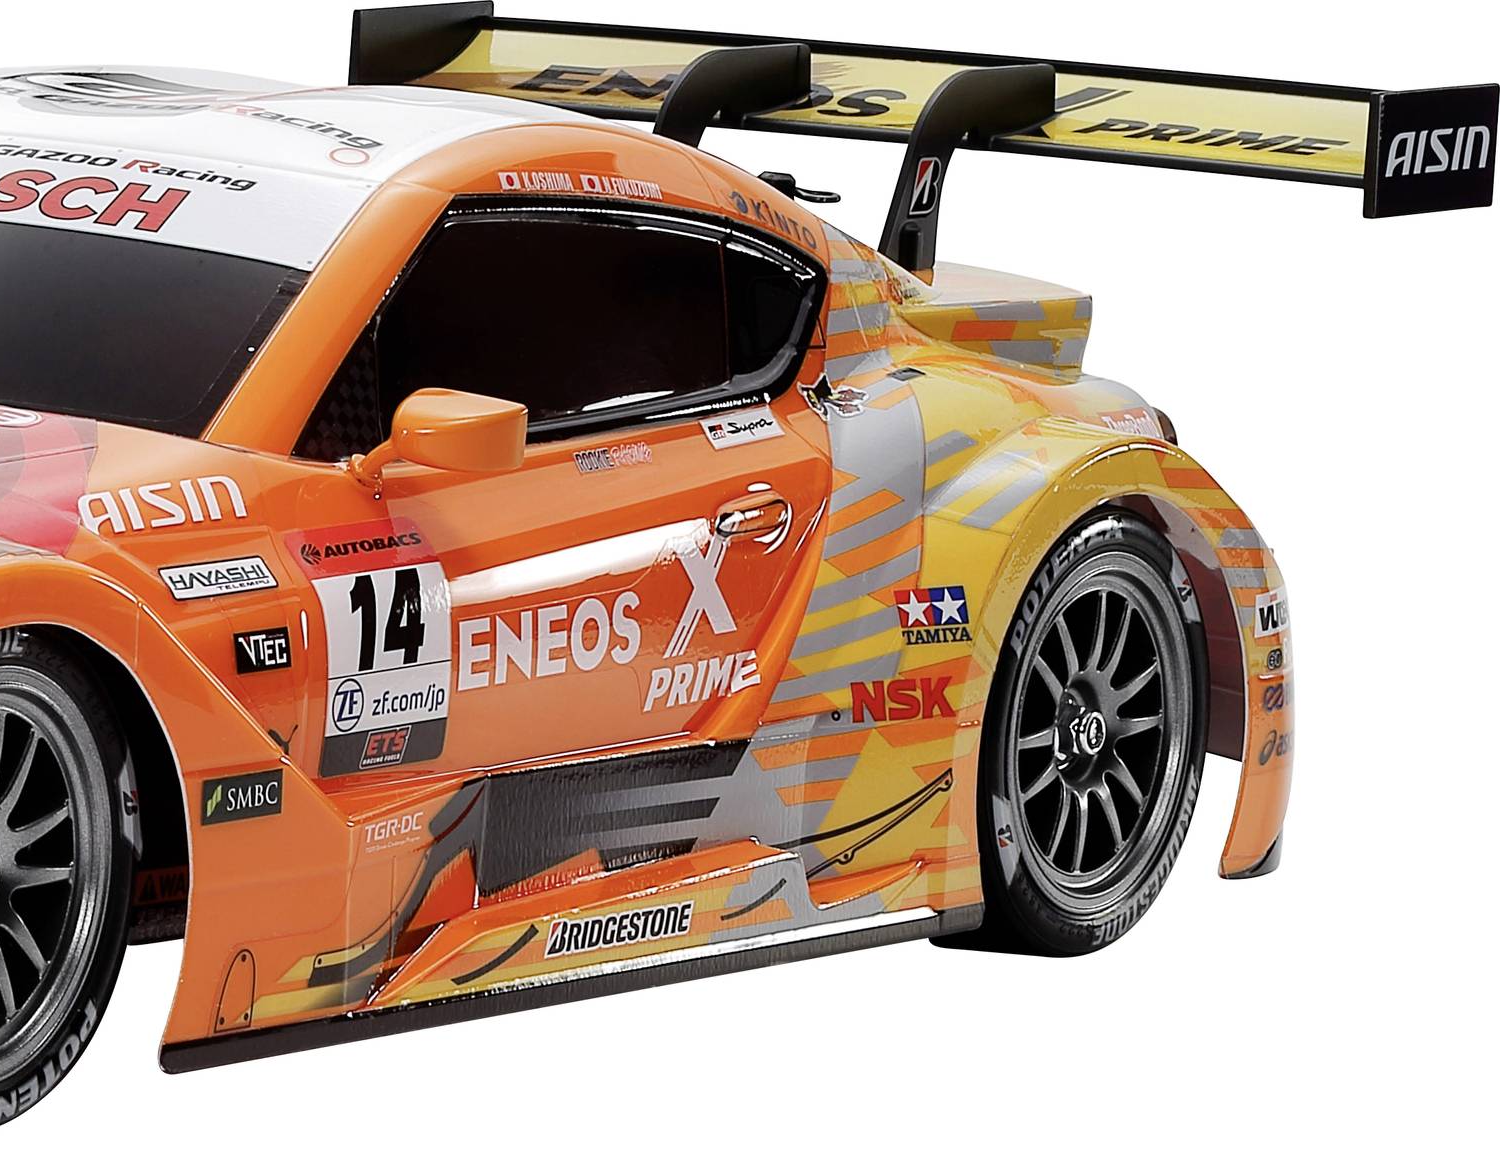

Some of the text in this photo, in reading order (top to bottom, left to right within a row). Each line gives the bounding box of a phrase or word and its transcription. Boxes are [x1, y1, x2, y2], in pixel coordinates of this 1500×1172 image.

[213, 103, 385, 150] Racing
[1074, 117, 1351, 156] PRIME
[1384, 124, 1491, 178] AISIN
[121, 158, 259, 192] Racing
[521, 171, 575, 192] K.OSHIMA
[726, 417, 774, 437] Supra
[574, 448, 615, 472] ROOKIE
[77, 475, 248, 534] AISIN
[324, 532, 421, 559] AUTOBACS
[168, 564, 270, 590] HAYASHI
[349, 567, 426, 672] 14
[902, 627, 973, 645] TAMIYA
[238, 633, 288, 667] VTEC
[456, 590, 641, 692] ENEOS
[642, 649, 762, 713] PRIME
[336, 683, 445, 722] ZF zf.com/jp
[850, 676, 957, 724] NSK
[366, 728, 409, 758] ETS
[226, 780, 279, 810] SMBC
[548, 902, 691, 957] BRIDGESTONE
